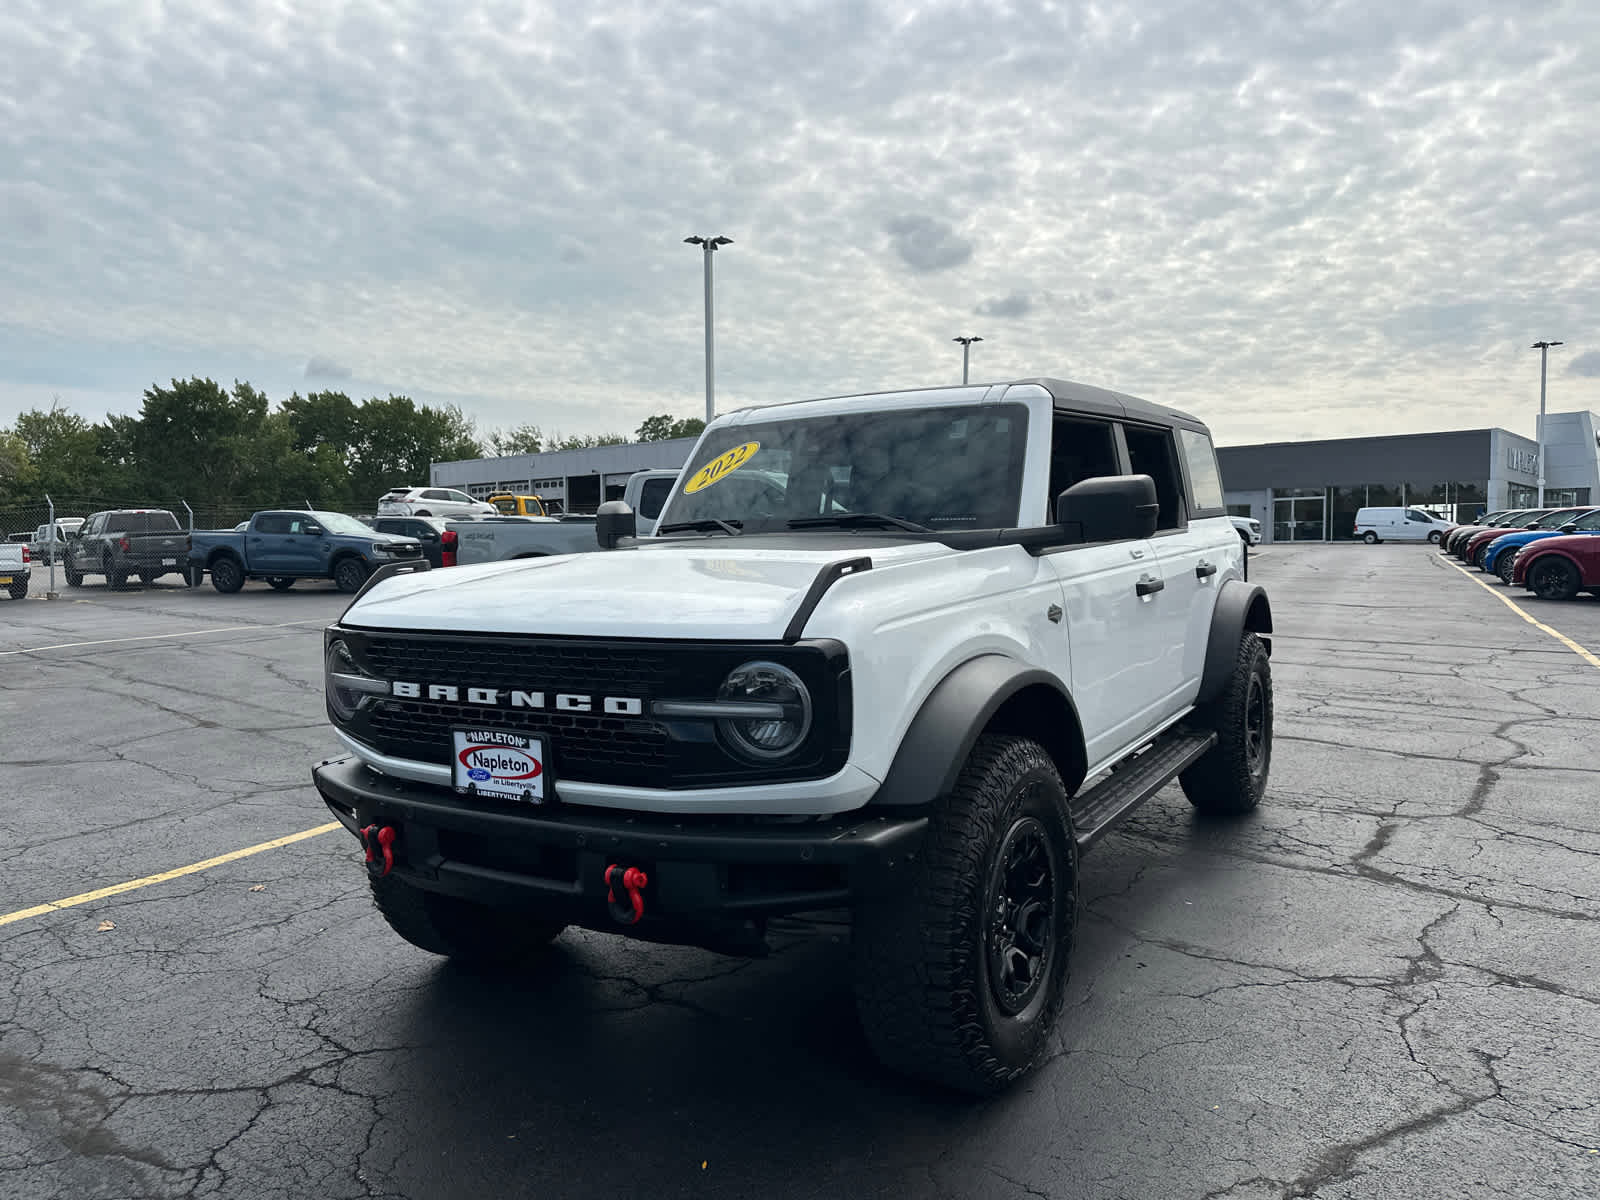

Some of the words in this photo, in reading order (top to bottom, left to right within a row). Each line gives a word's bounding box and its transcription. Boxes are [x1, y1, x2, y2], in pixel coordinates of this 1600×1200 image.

[698, 445, 748, 488] 2022
[392, 681, 642, 715] BRONCO
[473, 751, 529, 773] Napleton
[476, 790, 521, 801] LIBERTYVILLE
[501, 780, 536, 790] Libertyville
